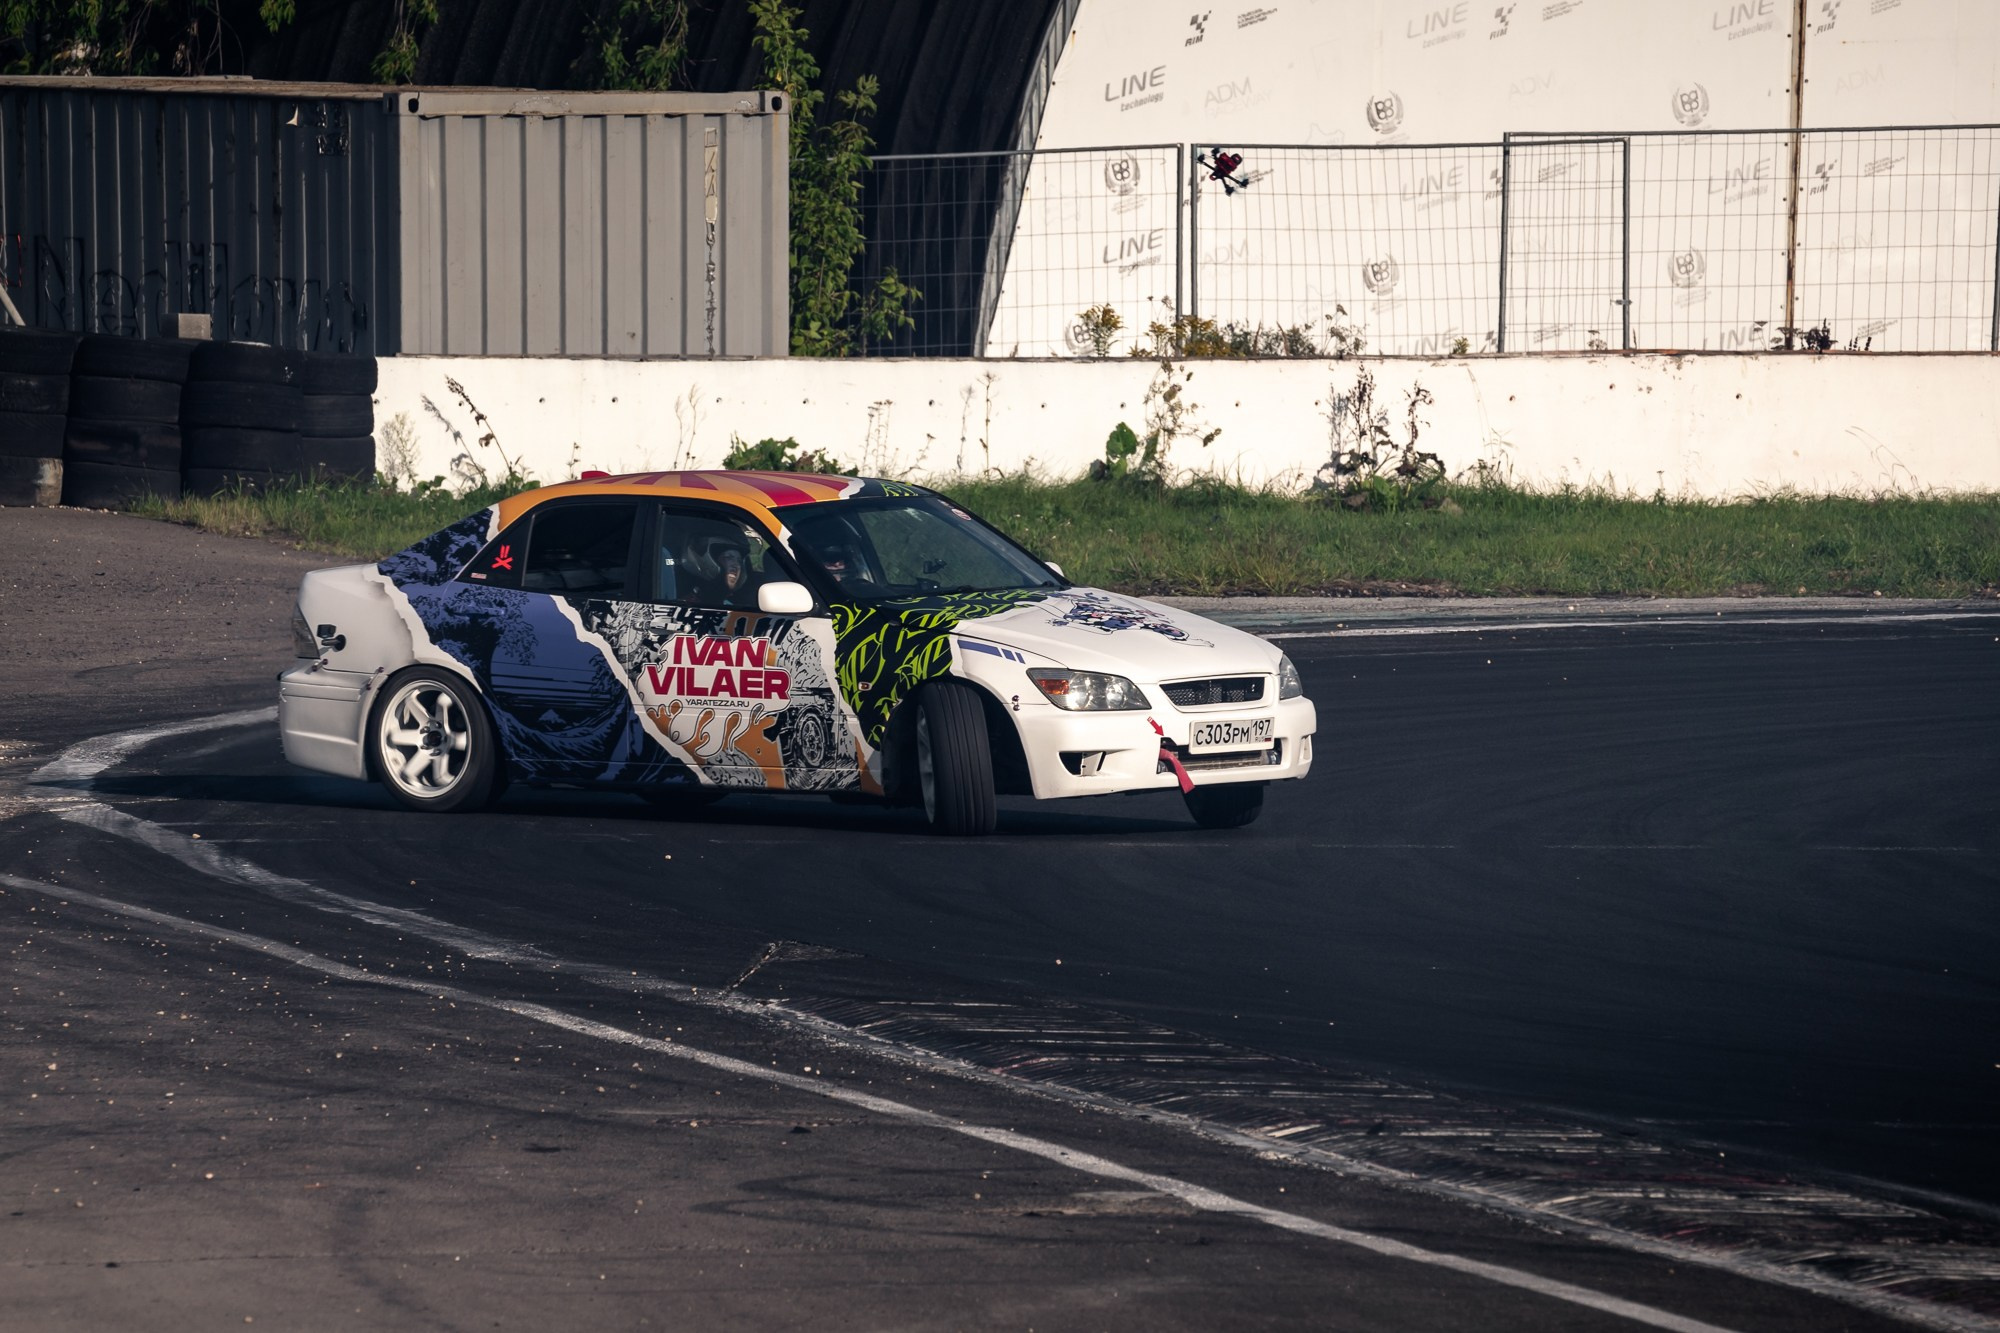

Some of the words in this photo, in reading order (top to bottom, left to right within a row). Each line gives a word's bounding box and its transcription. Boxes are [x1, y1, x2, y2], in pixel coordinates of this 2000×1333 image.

[1407, 1, 1469, 38] LINE
[1712, 0, 1774, 31] LINE
[1728, 21, 1773, 41] technology
[1105, 64, 1167, 102] LINE
[1120, 91, 1164, 112] technology
[1103, 228, 1164, 264] LINE
[673, 636, 768, 668] IVAN
[647, 665, 791, 700] VILAER
[685, 698, 750, 709] YARATEZZA.RU
[1253, 719, 1271, 736] 197
